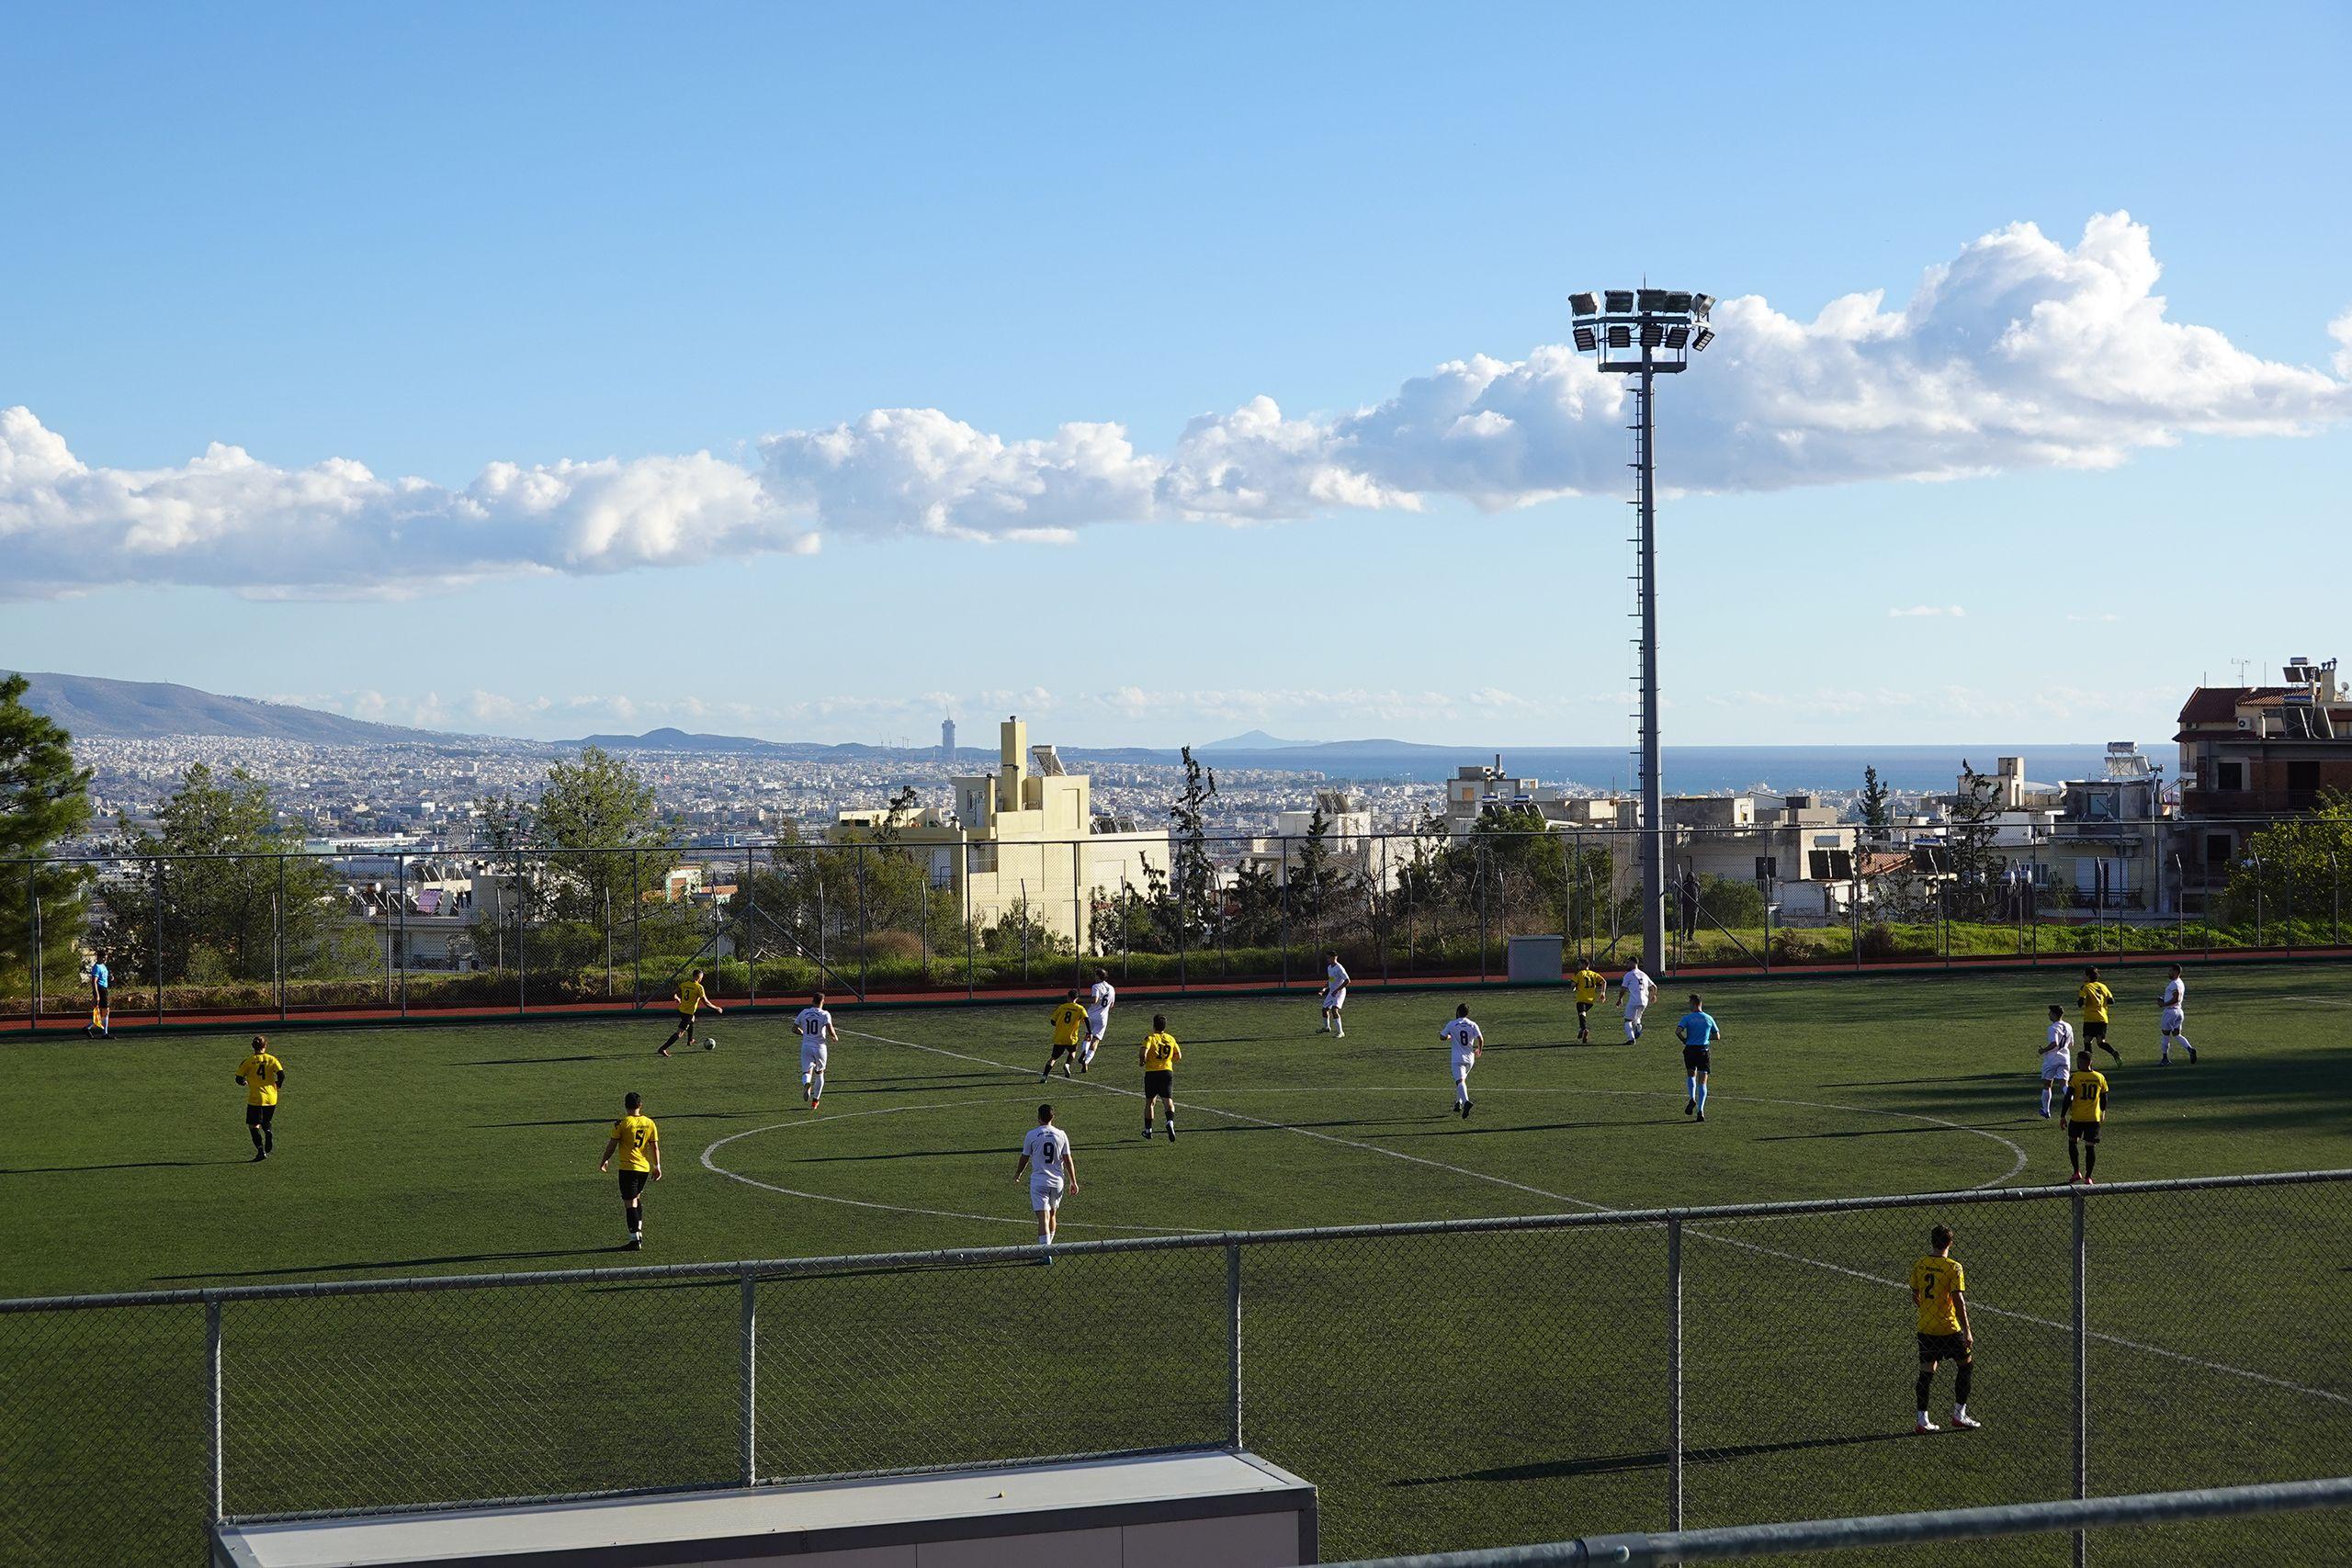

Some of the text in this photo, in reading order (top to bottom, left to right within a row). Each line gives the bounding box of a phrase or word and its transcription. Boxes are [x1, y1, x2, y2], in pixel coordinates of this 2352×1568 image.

[684, 989, 690, 1001] 3
[1101, 994, 1109, 1008] 6
[1064, 1010, 1072, 1024] 8
[805, 1018, 819, 1035] 10
[1459, 1030, 1469, 1046] 8
[256, 1064, 266, 1080] 4
[2080, 1083, 2098, 1100] 10
[635, 1130, 645, 1148] 5
[1044, 1142, 1055, 1164] 9
[1925, 1273, 1935, 1300] 2
